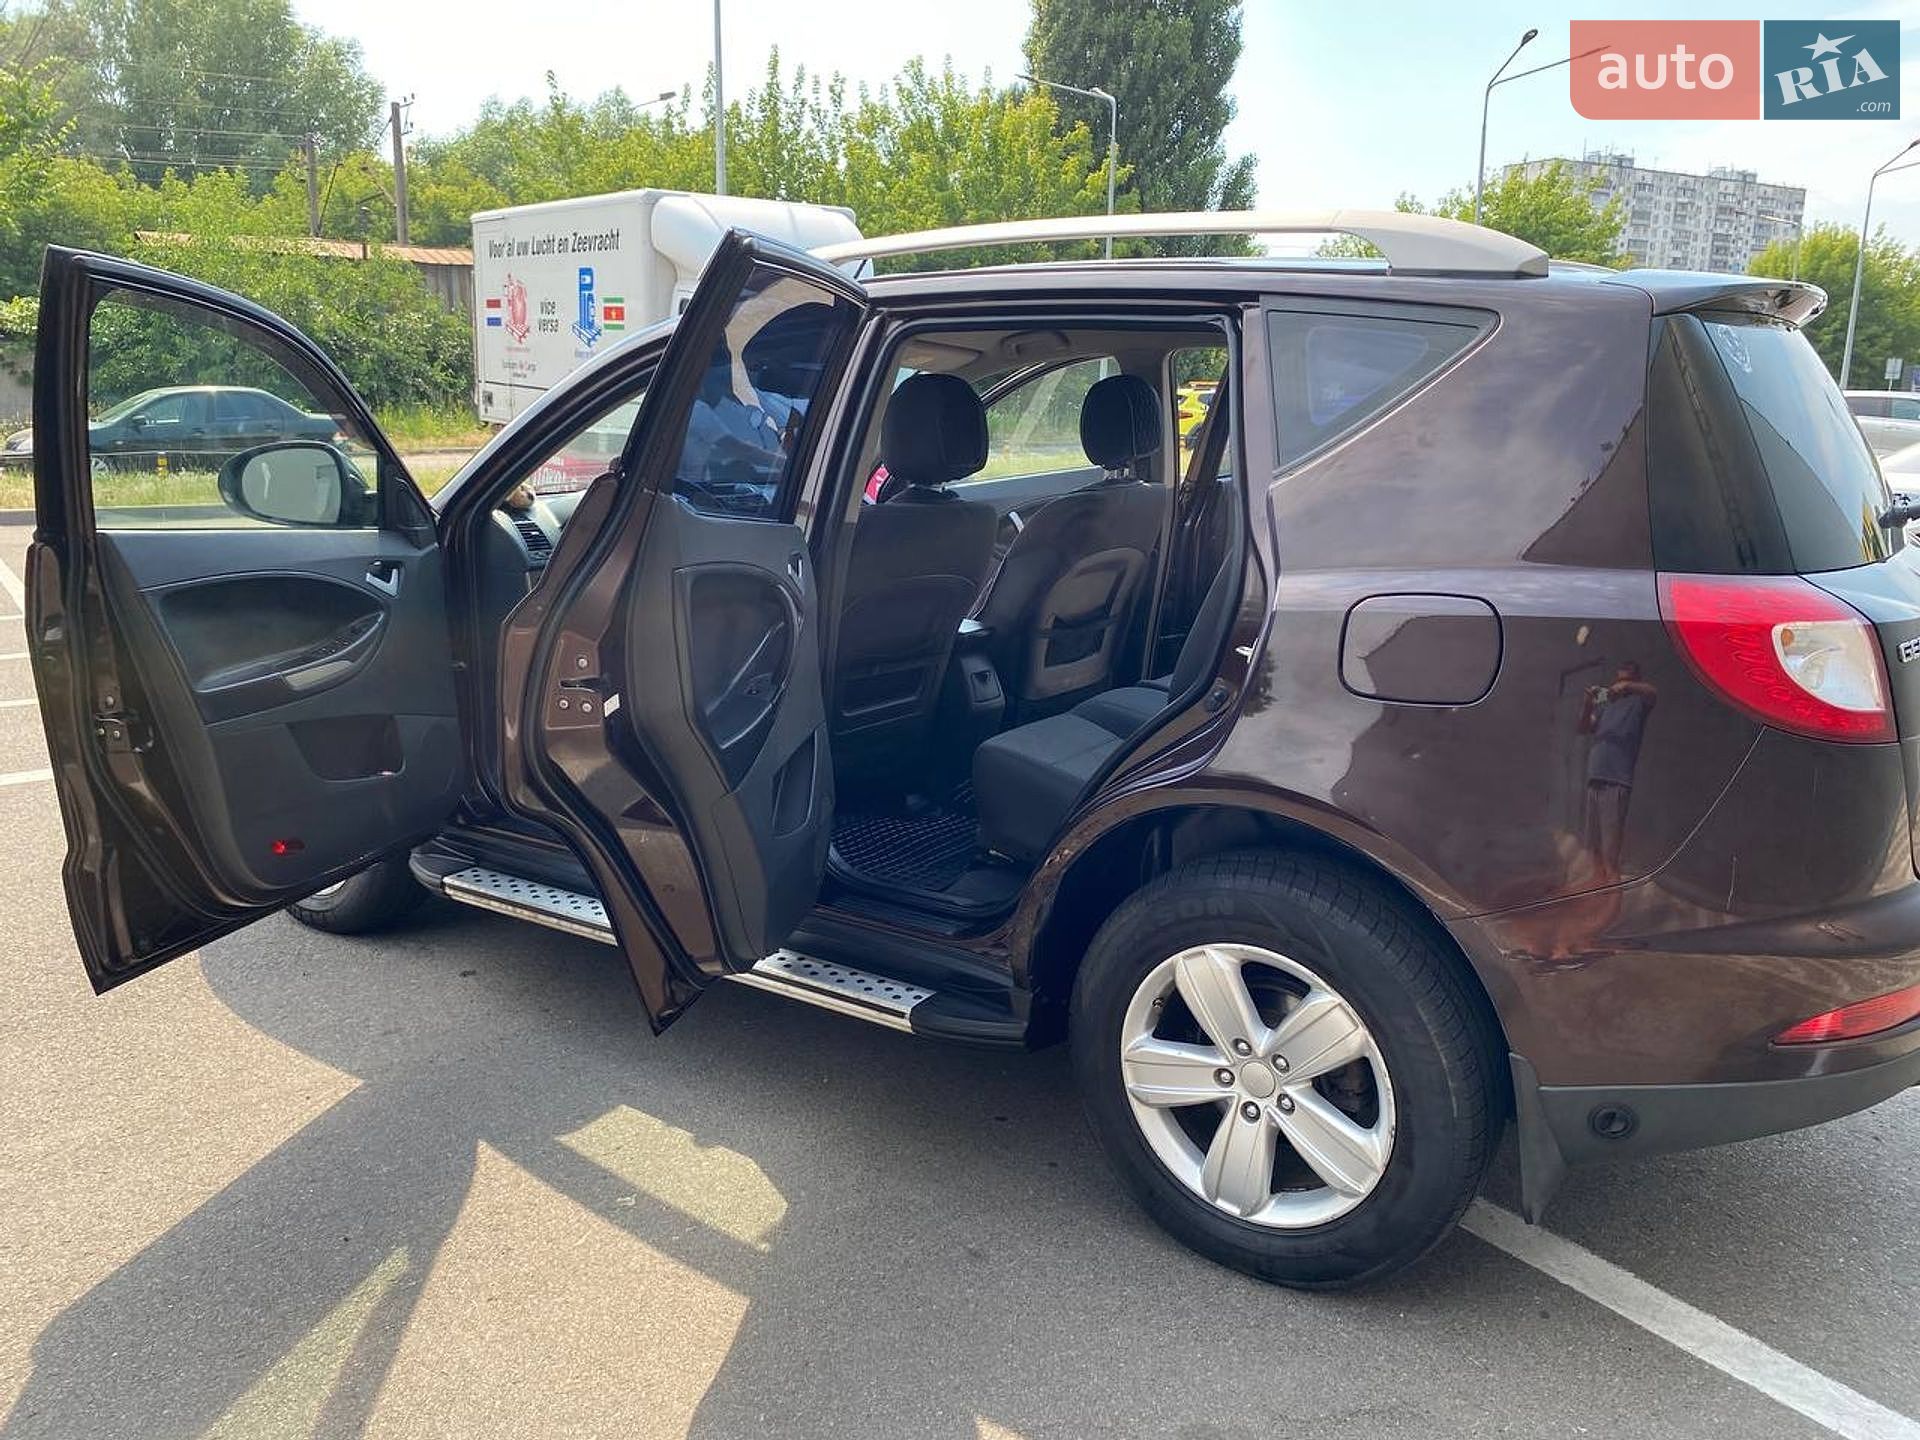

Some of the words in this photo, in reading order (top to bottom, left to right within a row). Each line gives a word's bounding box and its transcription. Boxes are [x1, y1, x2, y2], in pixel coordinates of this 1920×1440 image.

[489, 239, 505, 259] Voor
[507, 238, 515, 257] al
[517, 240, 528, 256] uw
[531, 234, 555, 255] Lucht
[558, 237, 569, 254] en
[572, 228, 620, 253] Zeevracht
[540, 299, 556, 315] vice
[538, 318, 559, 333] versa
